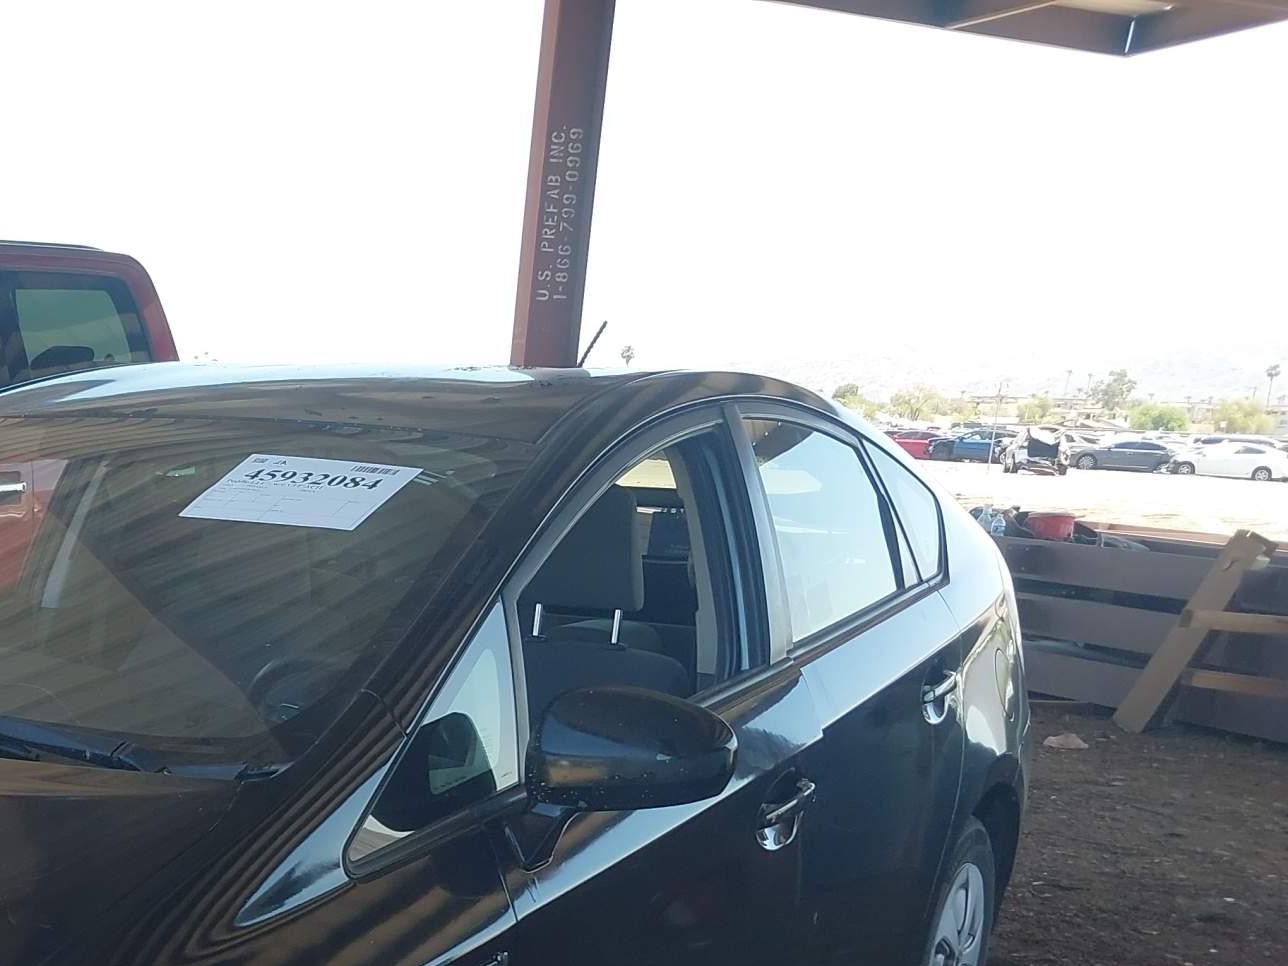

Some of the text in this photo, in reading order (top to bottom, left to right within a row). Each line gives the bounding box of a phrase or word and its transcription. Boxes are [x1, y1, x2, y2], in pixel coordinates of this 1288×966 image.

[536, 125, 567, 301] U.S. PREFAB INC.
[244, 468, 383, 491] 45932084
